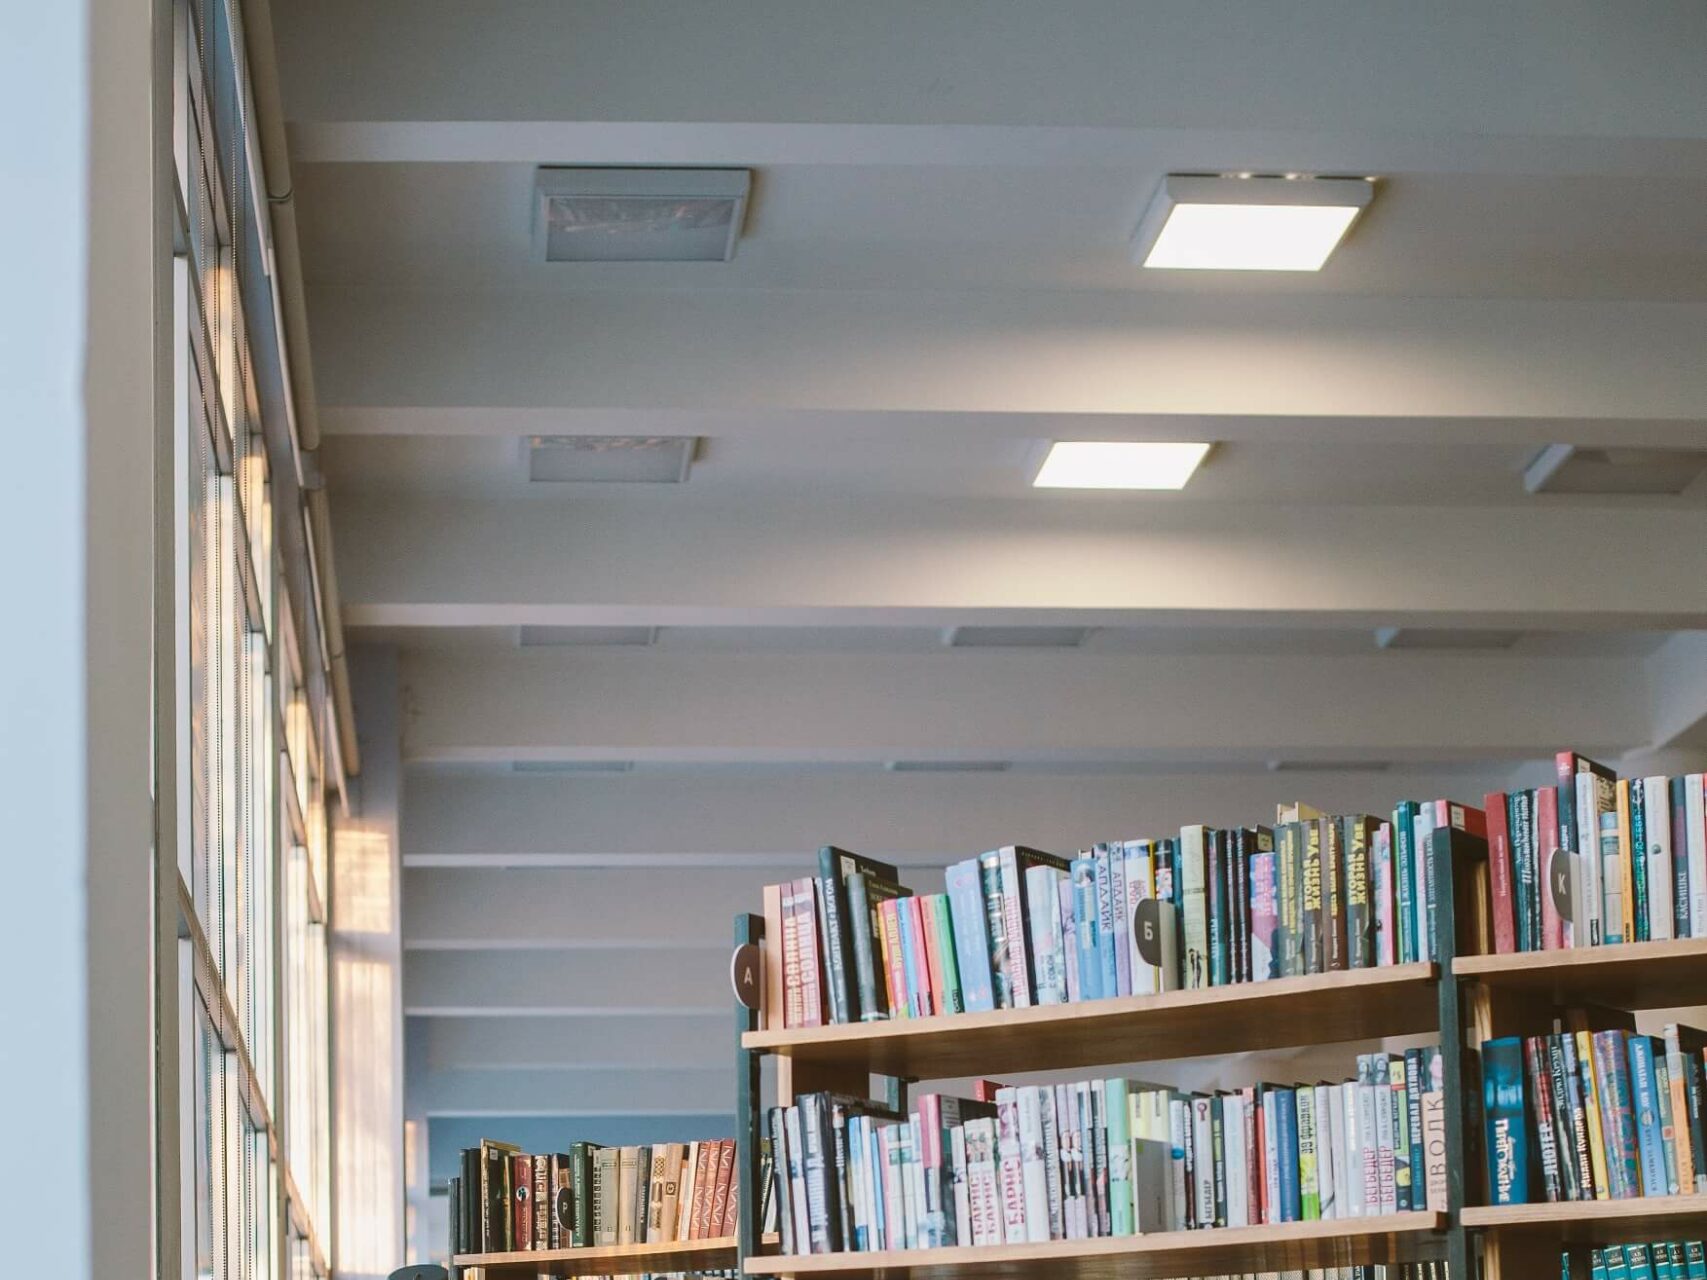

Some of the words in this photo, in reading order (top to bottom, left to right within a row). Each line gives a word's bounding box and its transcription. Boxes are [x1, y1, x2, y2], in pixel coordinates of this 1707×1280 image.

[1399, 831, 1408, 866] ЭЛЬФОВ
[823, 878, 837, 913] БОГОМ
[1098, 866, 1111, 930] АПДАЙК
[1113, 872, 1123, 922] АПДАЙК
[1303, 859, 1313, 911] ВТОРАЯ
[1310, 859, 1321, 909] ЖИЗНЬ
[1347, 854, 1357, 905] ВТОРАЯ
[1355, 852, 1366, 904] ЖИЗНЬ
[1401, 868, 1409, 899] ЖИЗНЬ
[1557, 873, 1566, 894] К
[828, 920, 843, 970] КОНТРАКТ
[1144, 921, 1153, 940] Б
[1407, 1057, 1420, 1100] ДЯТЛОВА
[1551, 1046, 1562, 1076] Круми
[1300, 1095, 1314, 1140] франков
[1410, 1103, 1422, 1144] ПЕРЕВАЛ
[1426, 1097, 1444, 1176] ВОЛК
[1574, 1107, 1586, 1152] Кундера
[1634, 1043, 1648, 1088] ДЖОНАТАН
[1641, 1092, 1650, 1108] КОУ
[1646, 1150, 1657, 1192] ЗАМКНУЛСЯ
[1300, 1141, 1313, 1154] 99
[1578, 1154, 1592, 1188] Милан
[1003, 1160, 1019, 1226] БАРНС
[1362, 1147, 1378, 1204] БЕГБЕДЕР
[1380, 1145, 1394, 1203] БЕГБЕДЕР
[970, 1175, 984, 1236] БАРНС
[981, 1174, 996, 1234] БАРНС
[1203, 1180, 1212, 1220] БЕГБЕДЕР
